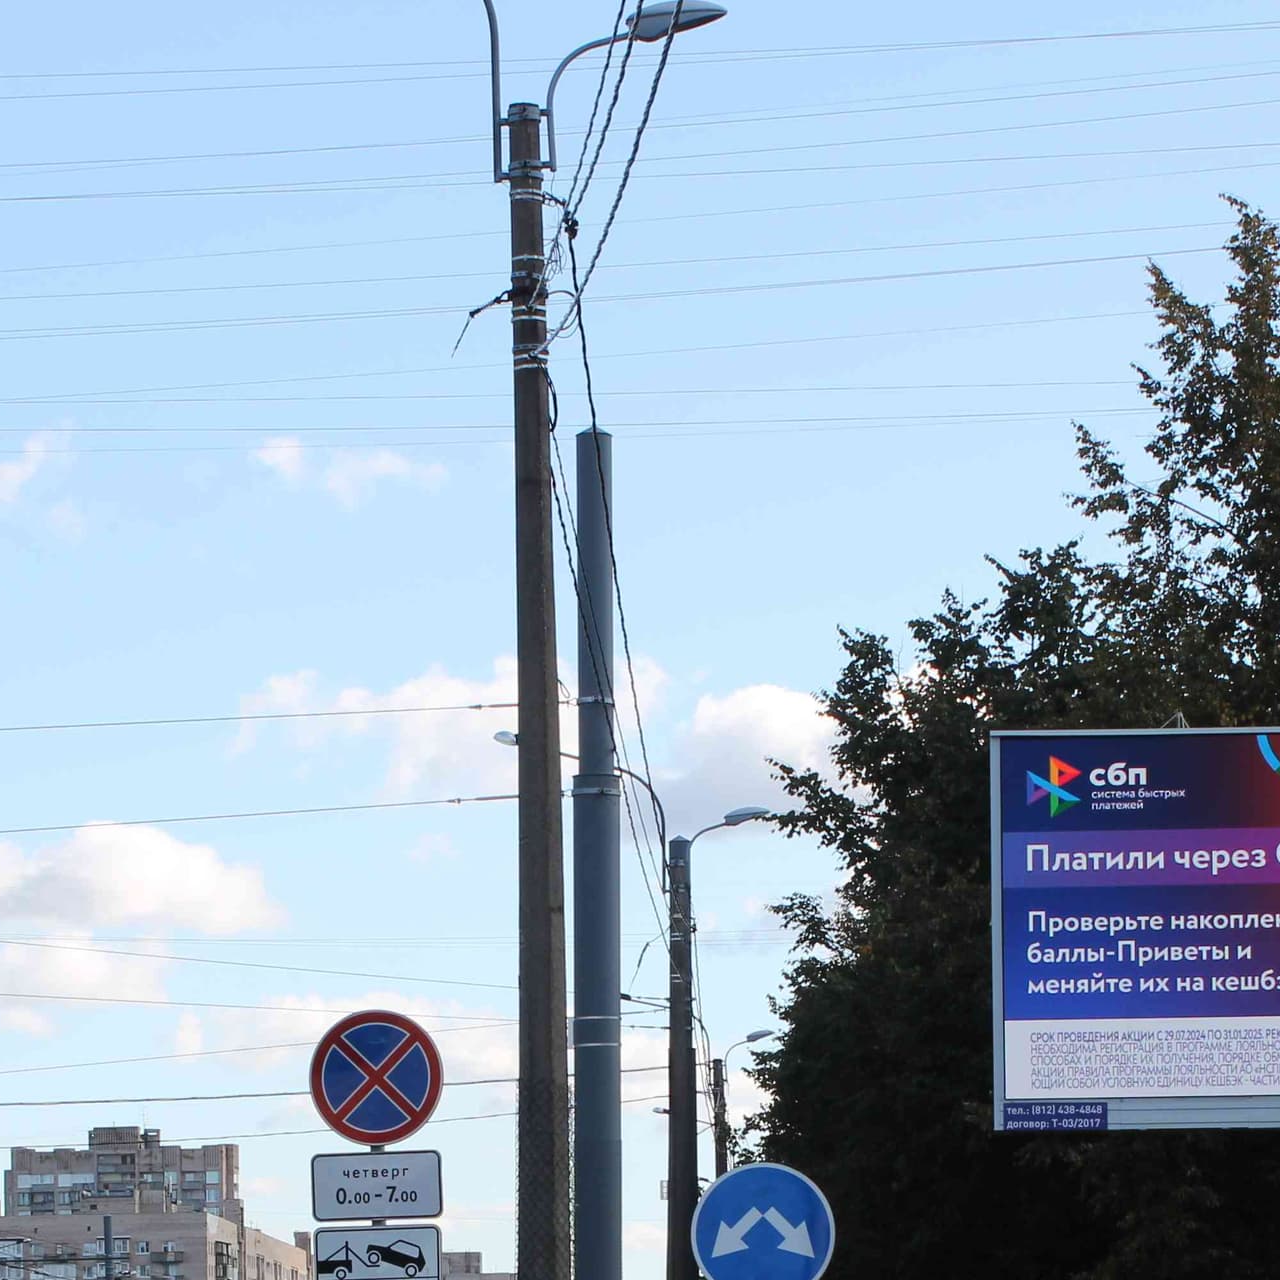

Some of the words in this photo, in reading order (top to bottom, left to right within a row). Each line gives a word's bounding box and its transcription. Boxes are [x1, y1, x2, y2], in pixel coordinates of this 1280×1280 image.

[1091, 790, 1135, 799] система
[1138, 787, 1185, 799] быстрых
[1092, 800, 1143, 810] платежей
[1025, 844, 1165, 872] Платили
[1174, 848, 1266, 875] через
[1028, 910, 1163, 937] Проверьте
[1027, 940, 1229, 966] баллы-Приветы
[1237, 945, 1252, 960] и
[1027, 973, 1137, 995] меняйте
[1139, 977, 1169, 993] их
[1176, 976, 1205, 992] на
[1030, 1032, 1055, 1042] СРОК
[1057, 1031, 1119, 1042] ПРОВЕДЕНИЯ
[1121, 1030, 1154, 1041] АКЦИИ
[1157, 1030, 1162, 1040] С
[1165, 1030, 1205, 1040] 29.07.2024
[1208, 1029, 1221, 1040] ПО
[1030, 1043, 1096, 1054] НЕОБХОДИМА
[1100, 1042, 1163, 1053] РЕГИСТРАЦИЯ
[1167, 1041, 1172, 1052] В
[1175, 1041, 1232, 1052] ПРОГРАММЕ
[1030, 1054, 1081, 1065] СПОСОБАХ
[1084, 1054, 1091, 1065] И
[1094, 1053, 1136, 1064] ПОРЯДКЕ
[1140, 1053, 1153, 1064] ИХ
[1218, 1052, 1260, 1063] ПОРЯДКЕ
[1067, 1066, 1110, 1076] ПРАВИЛА
[1112, 1065, 1171, 1076] ПРОГРАММЫ
[1173, 1064, 1237, 1075] ЛОЯЛЬНОСТИ
[1239, 1064, 1252, 1074] АО
[1102, 1076, 1154, 1088] УСЛОВНУЮ
[1206, 1075, 1242, 1086] КЕШБЭК
[1007, 1107, 1029, 1115] тел.:
[1031, 1105, 1056, 1116] (812)
[1058, 1105, 1102, 1115] 438-4848
[1007, 1119, 1049, 1130] договор:
[1051, 1118, 1101, 1129] Т-03/2017
[342, 1167, 409, 1180] четверг
